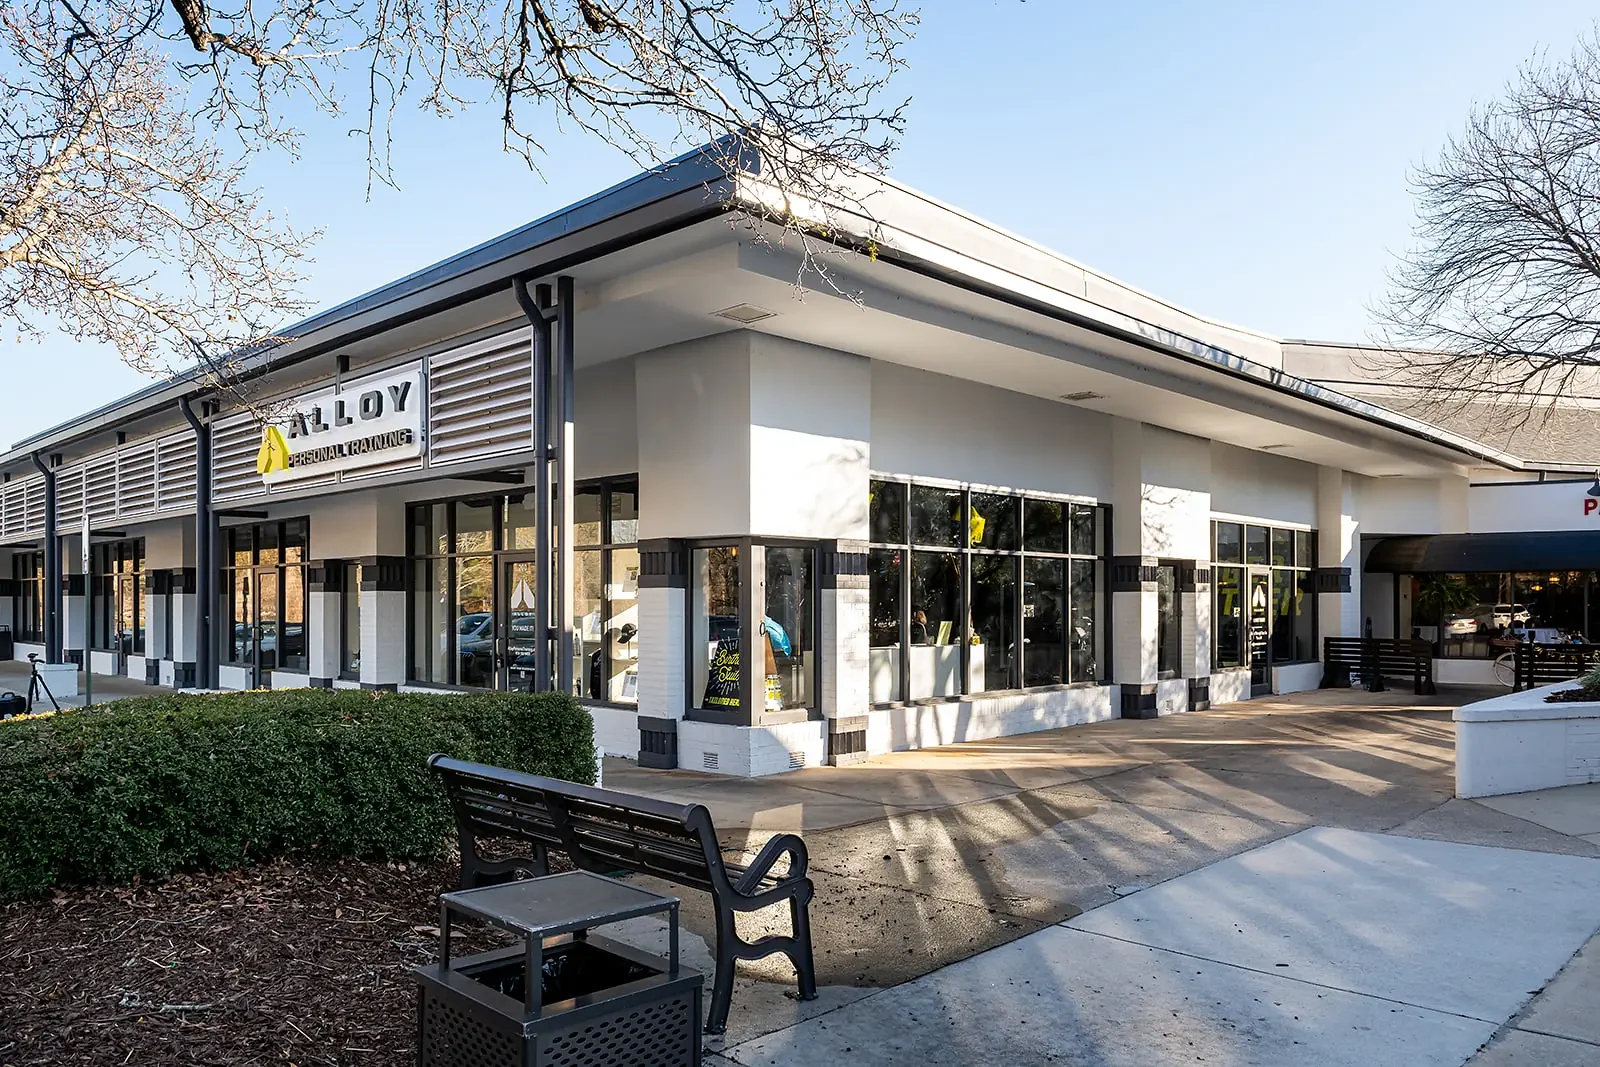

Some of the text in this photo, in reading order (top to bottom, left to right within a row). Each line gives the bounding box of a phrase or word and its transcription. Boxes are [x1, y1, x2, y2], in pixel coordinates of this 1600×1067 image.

[288, 381, 412, 439] ALLOY
[288, 428, 413, 468] PERSONAL TRAINING
[1584, 498, 1600, 516] P
